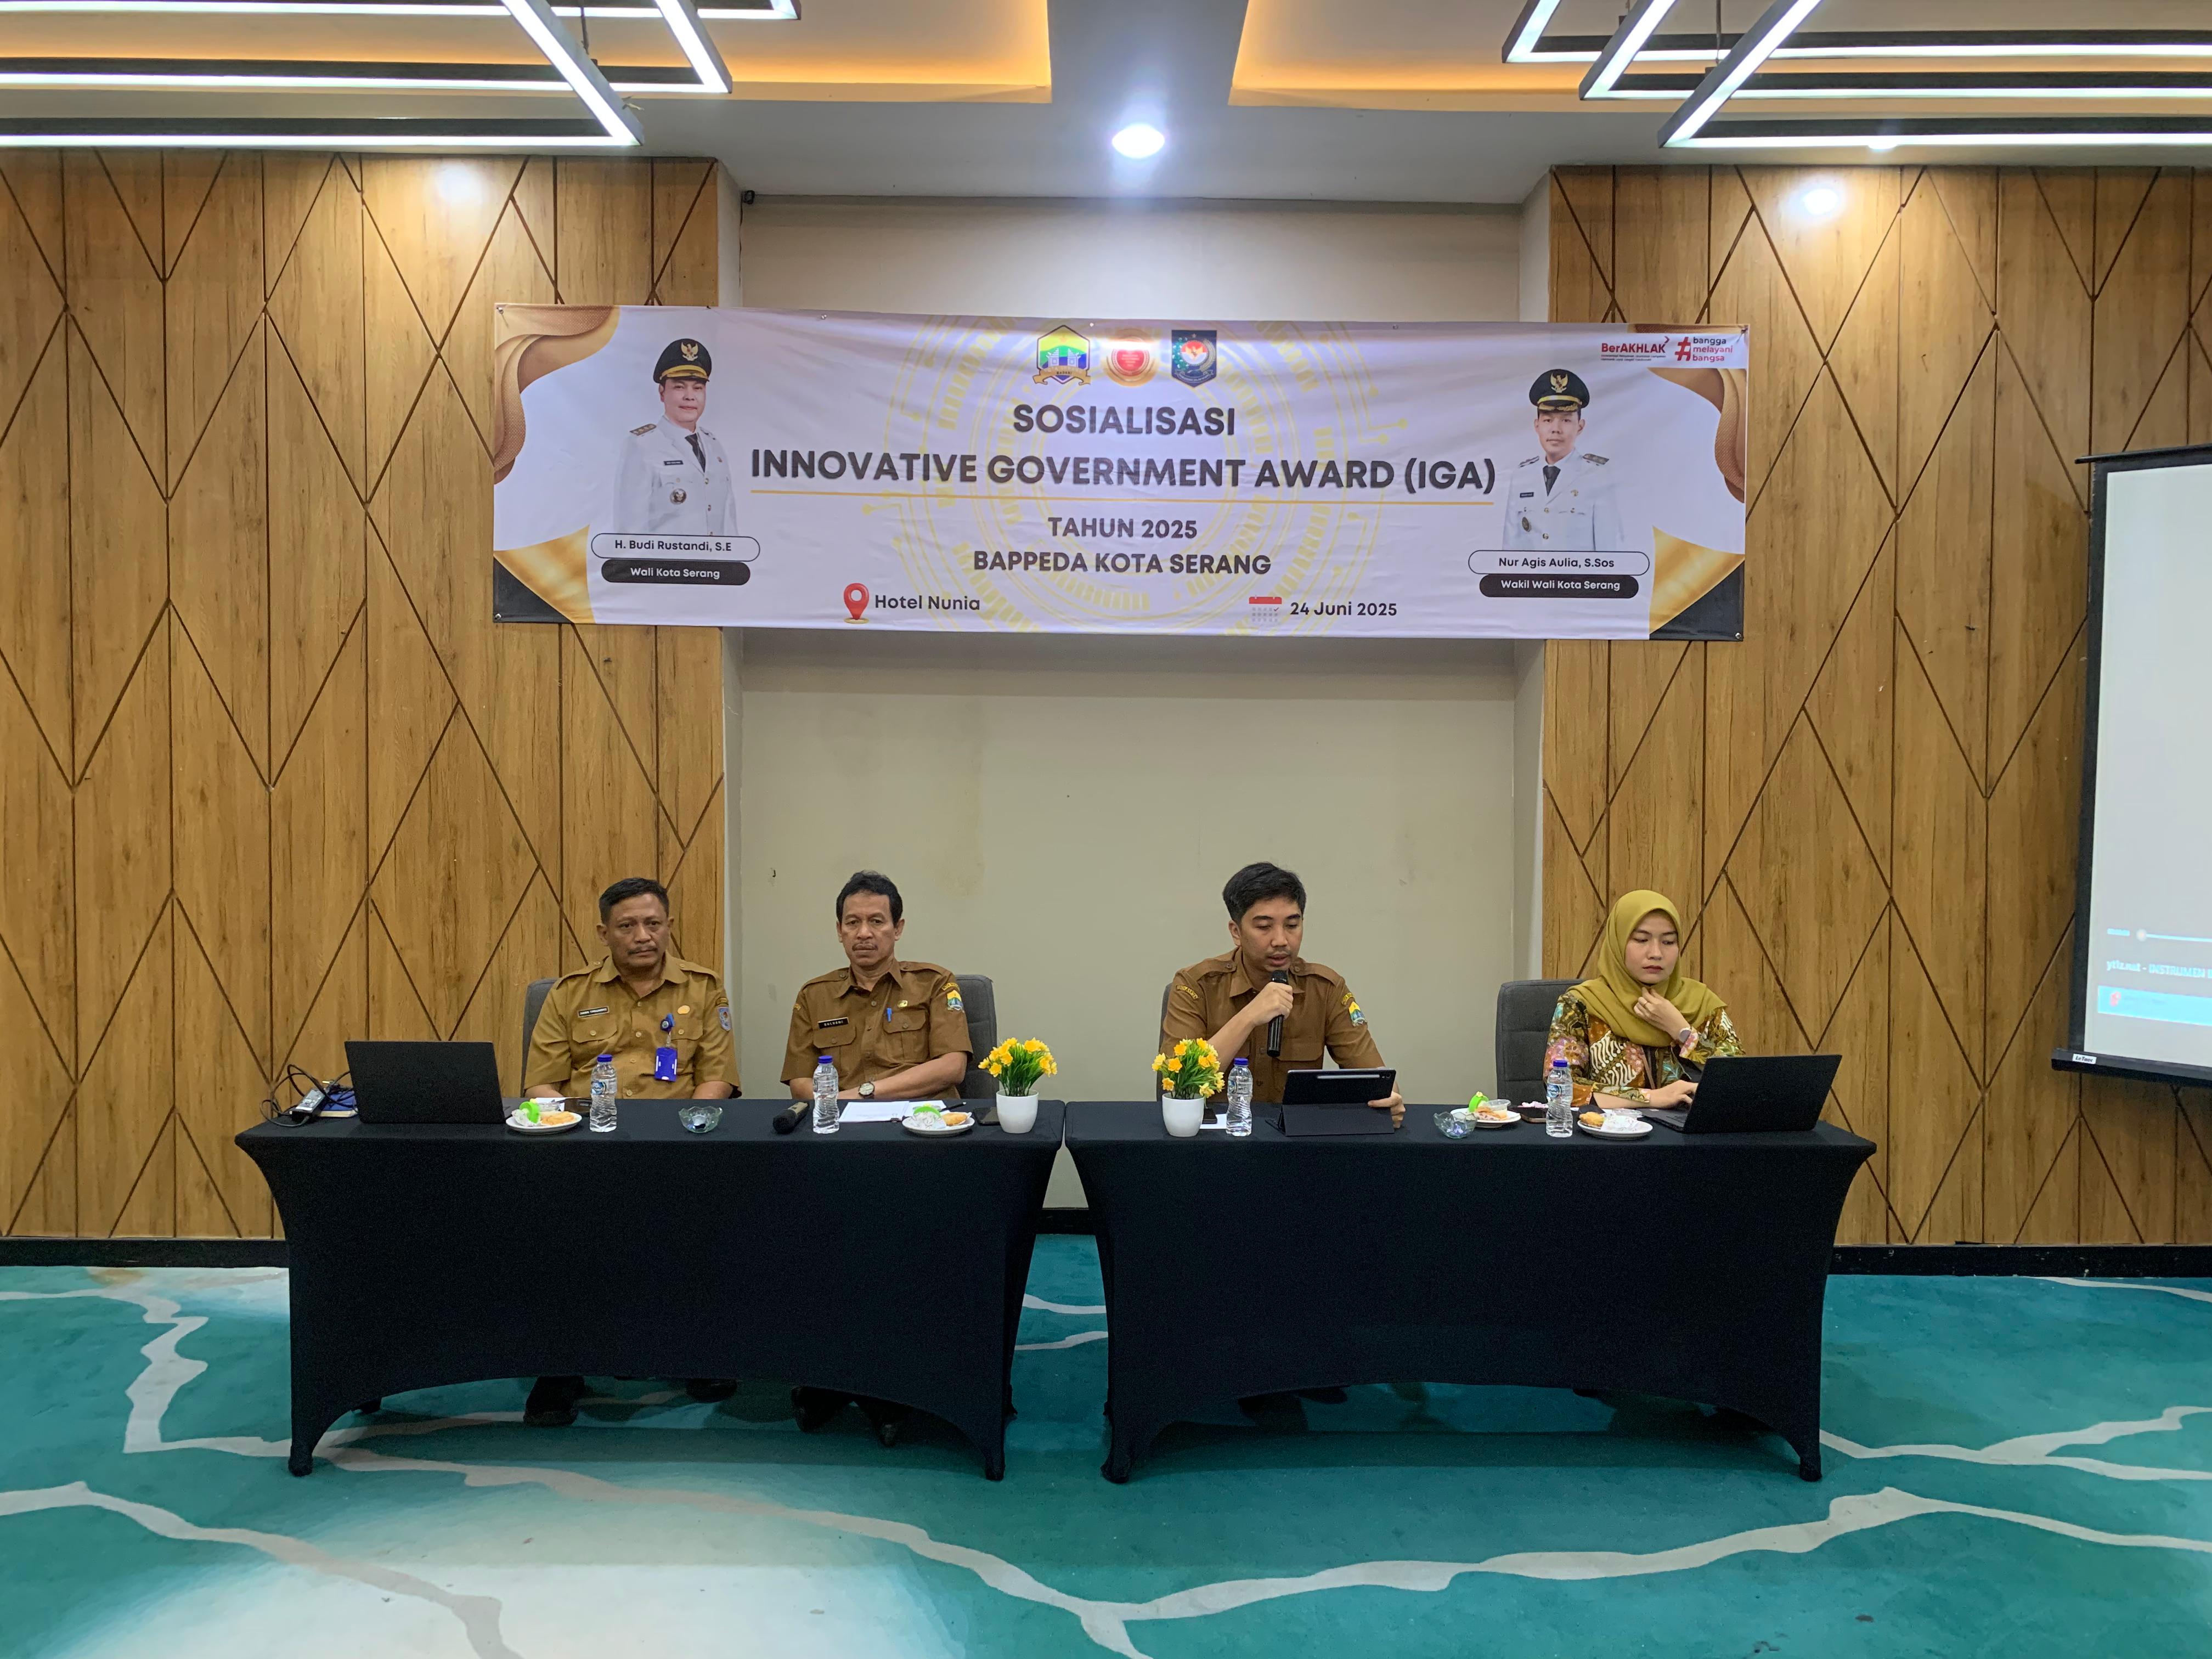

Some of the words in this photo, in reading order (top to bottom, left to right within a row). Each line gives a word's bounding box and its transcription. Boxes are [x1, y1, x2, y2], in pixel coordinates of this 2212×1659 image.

[1693, 337, 1726, 346] bangga
[1601, 343, 1666, 353] BerAKHLAK
[1693, 346, 1733, 354] melayani
[1692, 354, 1725, 362] bangsa
[1013, 404, 1234, 436] SOSIALISASI
[752, 449, 977, 482] INNOVATIVE
[988, 455, 1244, 487] GOVERNMENT
[1255, 460, 1394, 488] AWARD
[1405, 458, 1495, 494] (IGA)
[1048, 517, 1133, 538] TAHUN
[1142, 520, 1197, 539] 2025
[616, 540, 625, 549] H.
[630, 540, 654, 549] Budi
[658, 541, 712, 551] Rustandi,
[715, 542, 731, 551] S.E
[974, 551, 1087, 572] BAPPEDA
[1096, 553, 1163, 573] KOTA
[1170, 554, 1271, 574] SERANG
[1499, 558, 1519, 566] Nur
[1522, 557, 1545, 568] Agis
[1549, 558, 1581, 568] Aulia,
[1584, 558, 1614, 567] S.Sos
[657, 568, 680, 577] Kota
[683, 569, 720, 579] Serang
[1501, 580, 1529, 588] Wakil
[1584, 581, 1620, 591] Serang
[876, 595, 922, 609] Hotel
[928, 596, 979, 610] Nunia
[1290, 602, 1309, 615] 24
[1314, 602, 1351, 615] Juni
[1358, 603, 1397, 616] 2025
